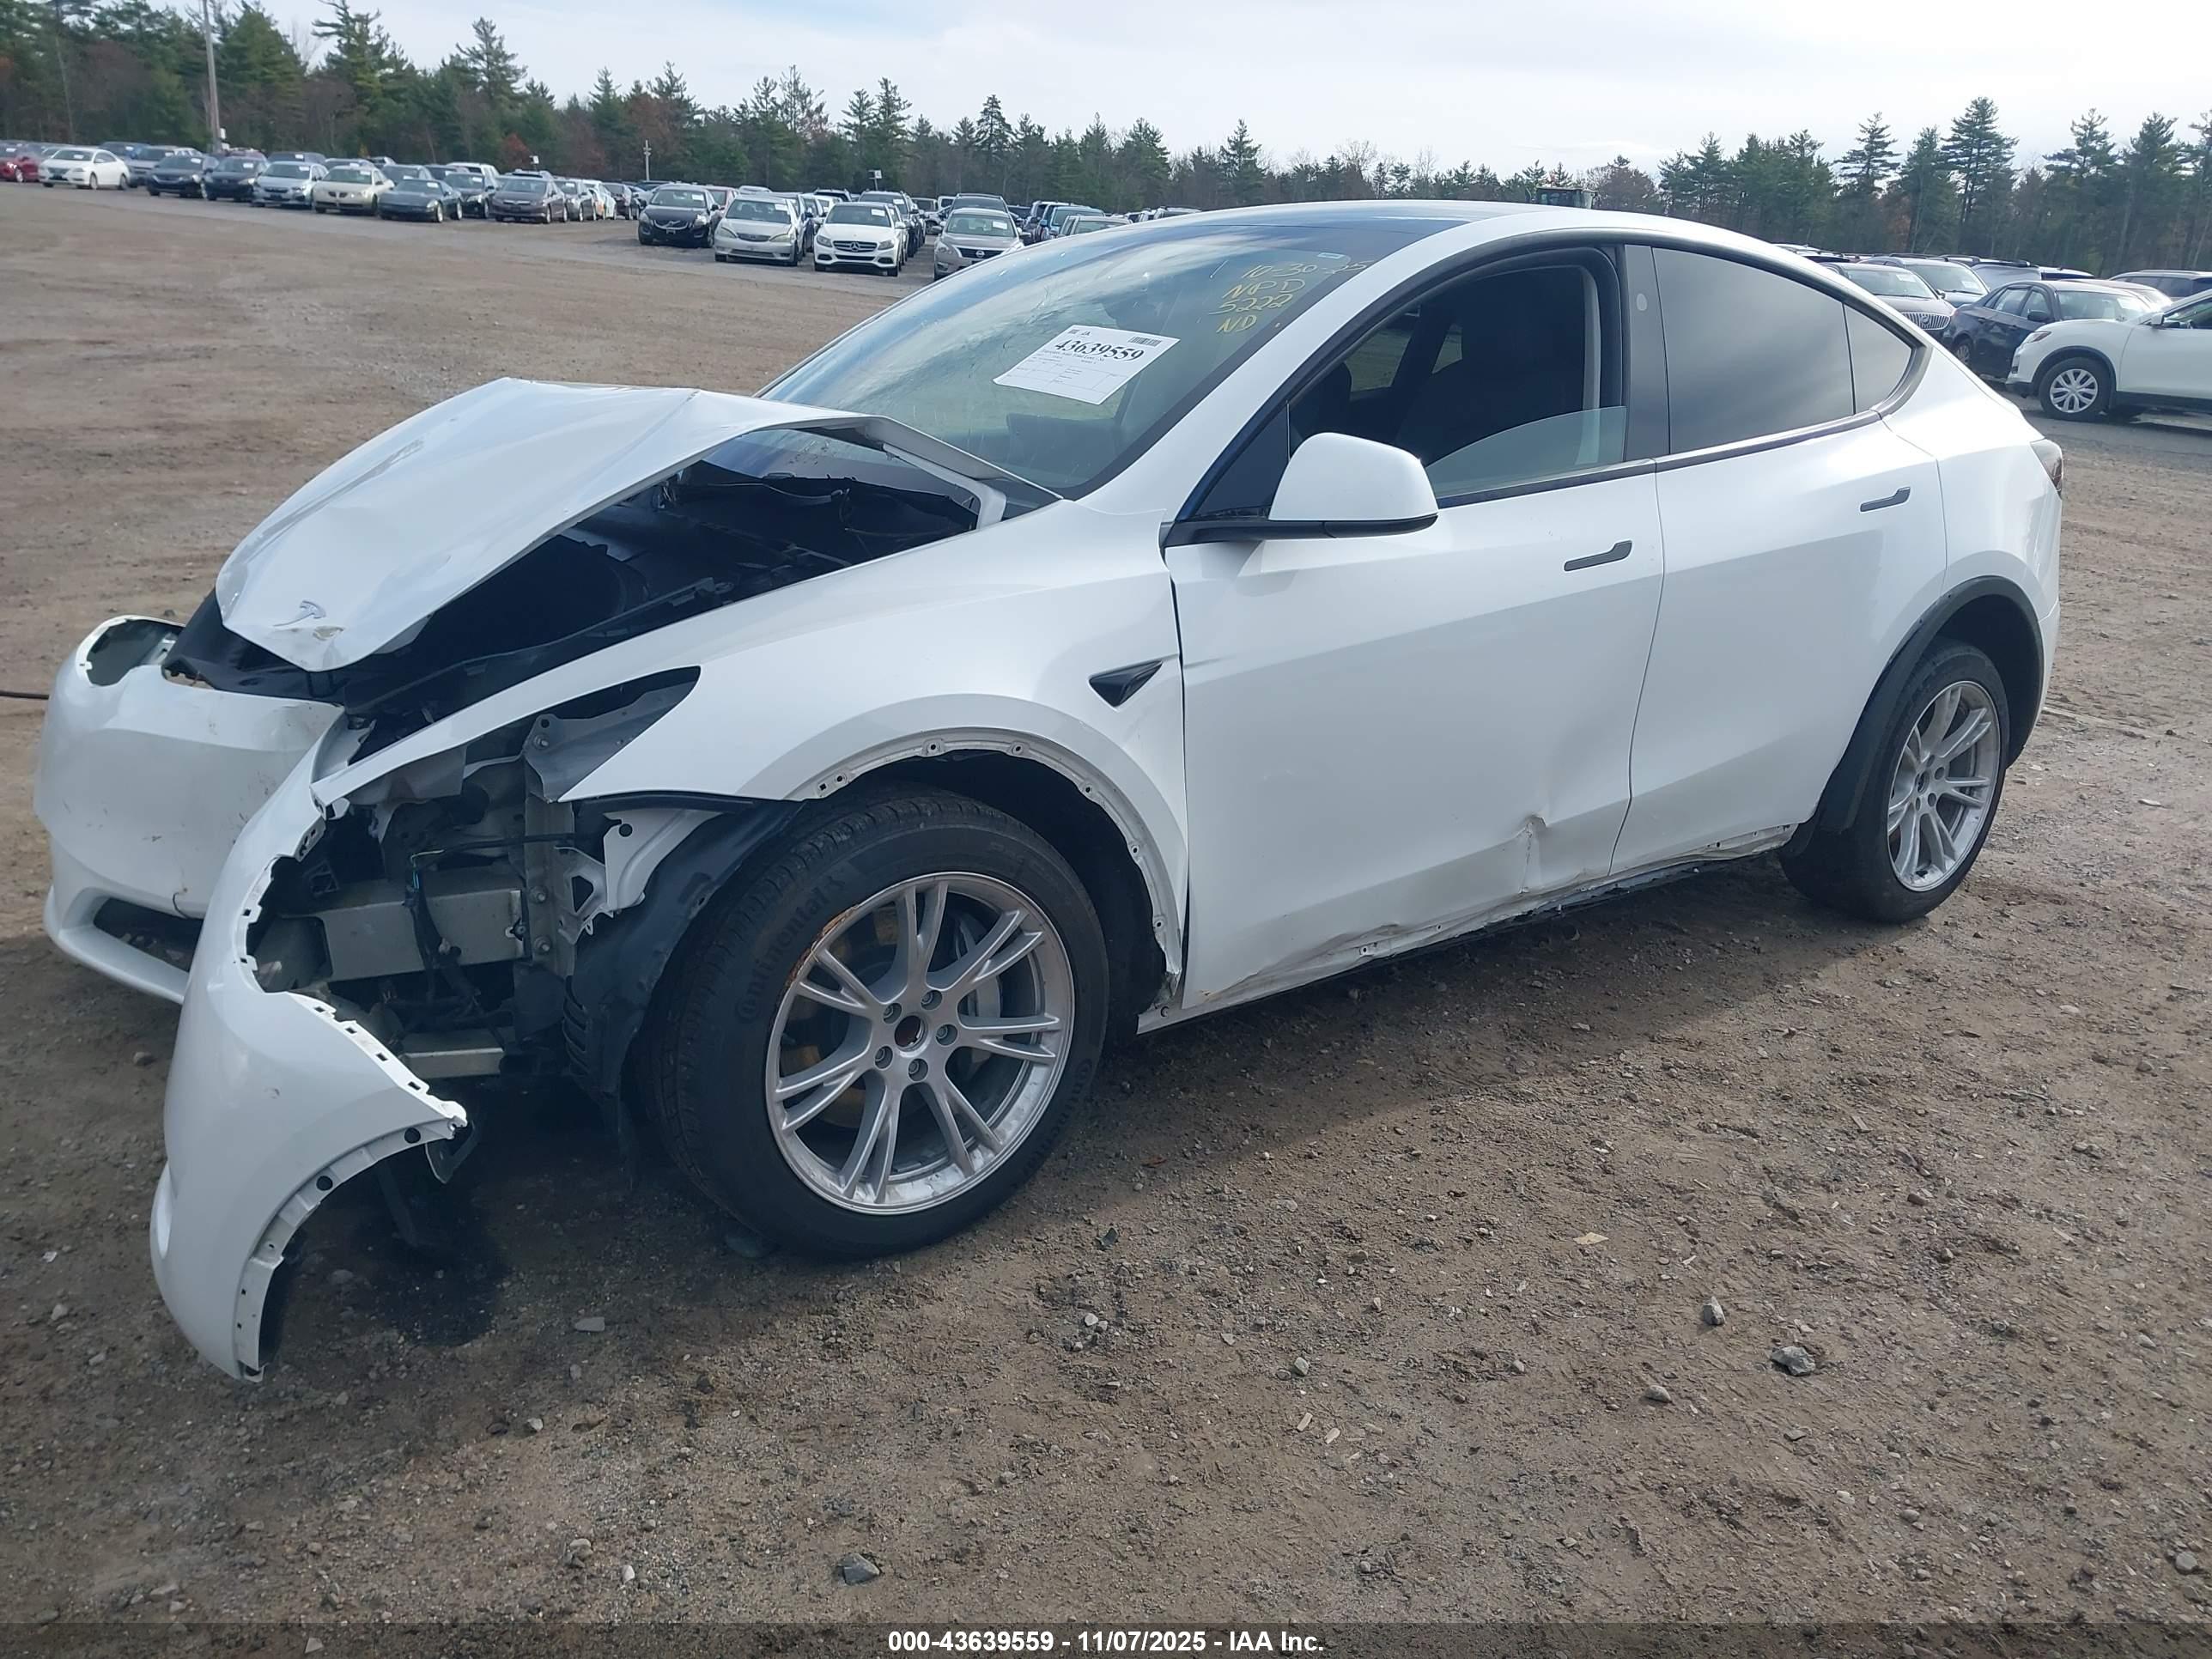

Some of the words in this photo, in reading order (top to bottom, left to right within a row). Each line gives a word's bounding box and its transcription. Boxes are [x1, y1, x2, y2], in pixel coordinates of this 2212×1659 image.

[1209, 294, 1293, 315] 5222
[1216, 314, 1257, 333] ND
[1054, 338, 1146, 362] 43639559
